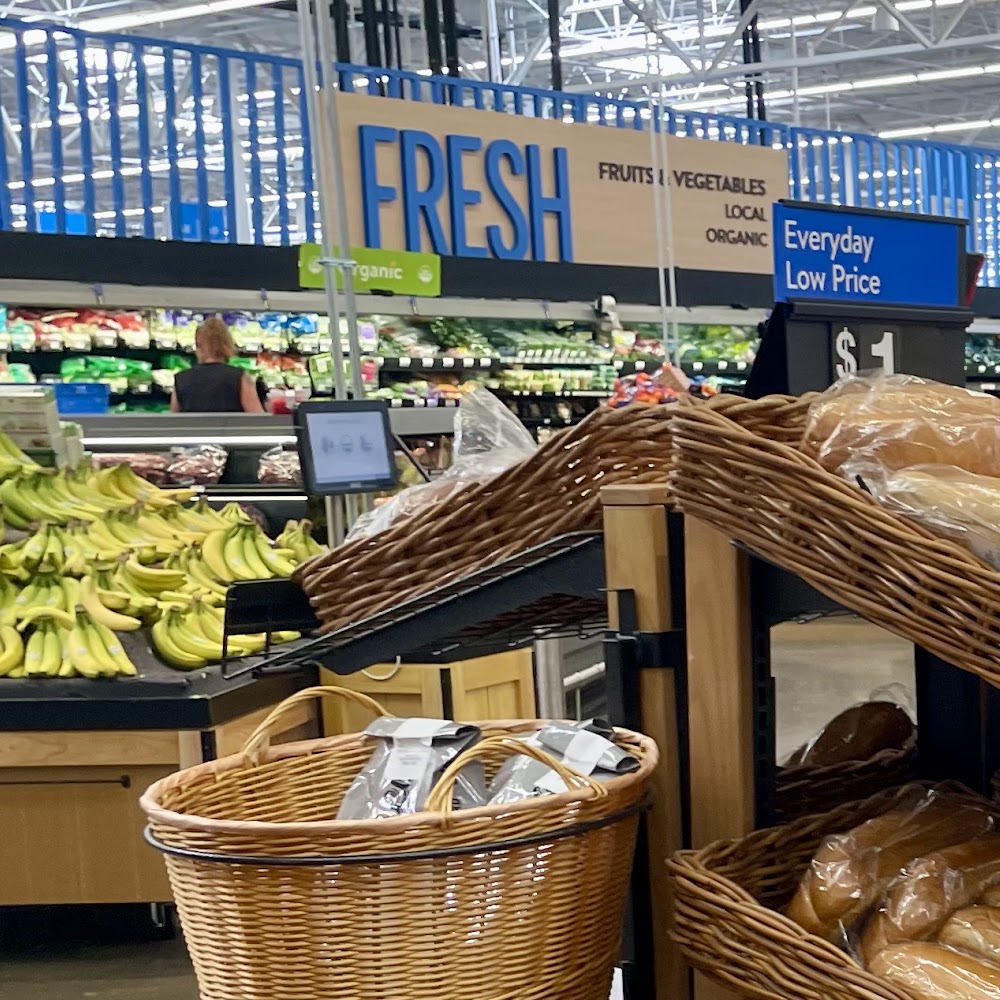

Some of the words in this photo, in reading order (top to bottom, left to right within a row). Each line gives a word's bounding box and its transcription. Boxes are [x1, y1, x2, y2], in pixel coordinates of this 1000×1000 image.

[358, 124, 574, 263] FRESH
[598, 162, 654, 185] FRUITS
[673, 170, 767, 196] VEGETABLES
[725, 203, 768, 222] LOCAL
[705, 227, 769, 247] ORGANIC
[784, 219, 875, 263] Everyday
[338, 261, 404, 282] rganic
[785, 260, 827, 291] Low
[832, 264, 881, 295] Price
